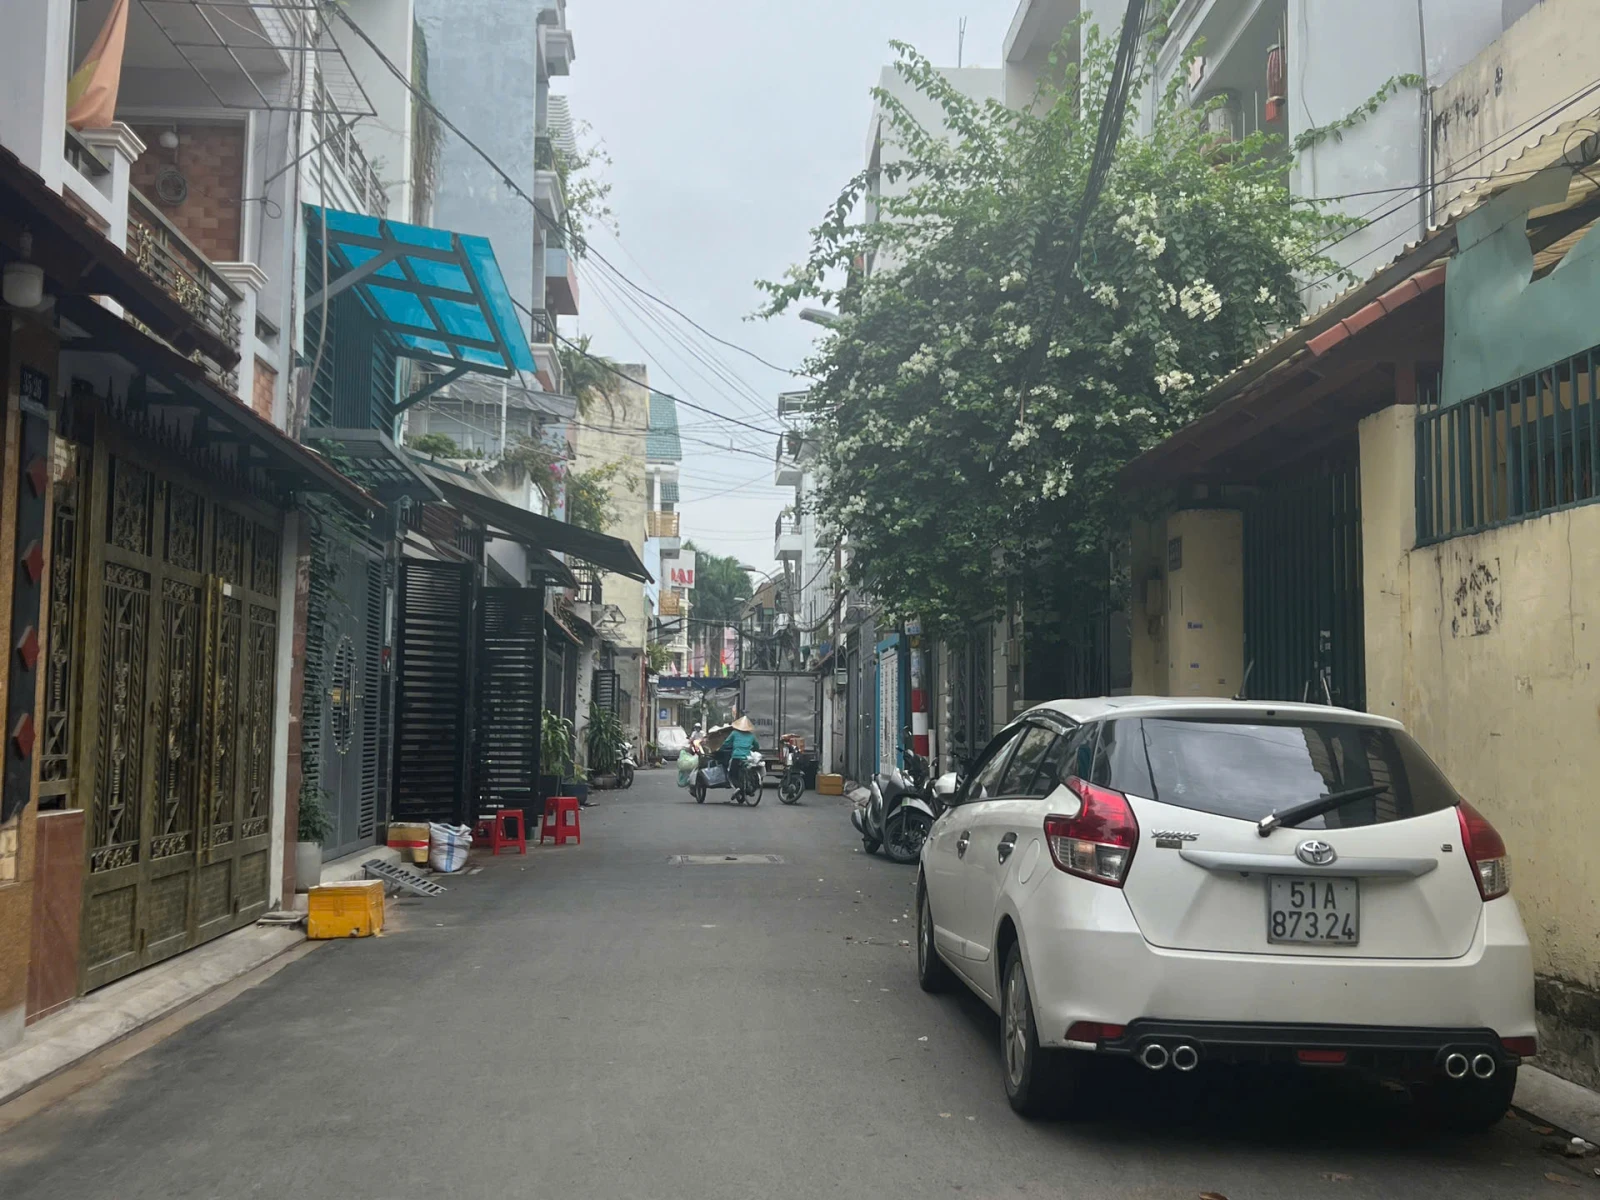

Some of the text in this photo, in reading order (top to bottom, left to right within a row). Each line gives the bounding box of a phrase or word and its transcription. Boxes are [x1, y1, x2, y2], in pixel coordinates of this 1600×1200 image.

[1150, 828, 1200, 842] YARIS
[1290, 881, 1336, 910] 51A
[1272, 910, 1355, 940] 873.24
